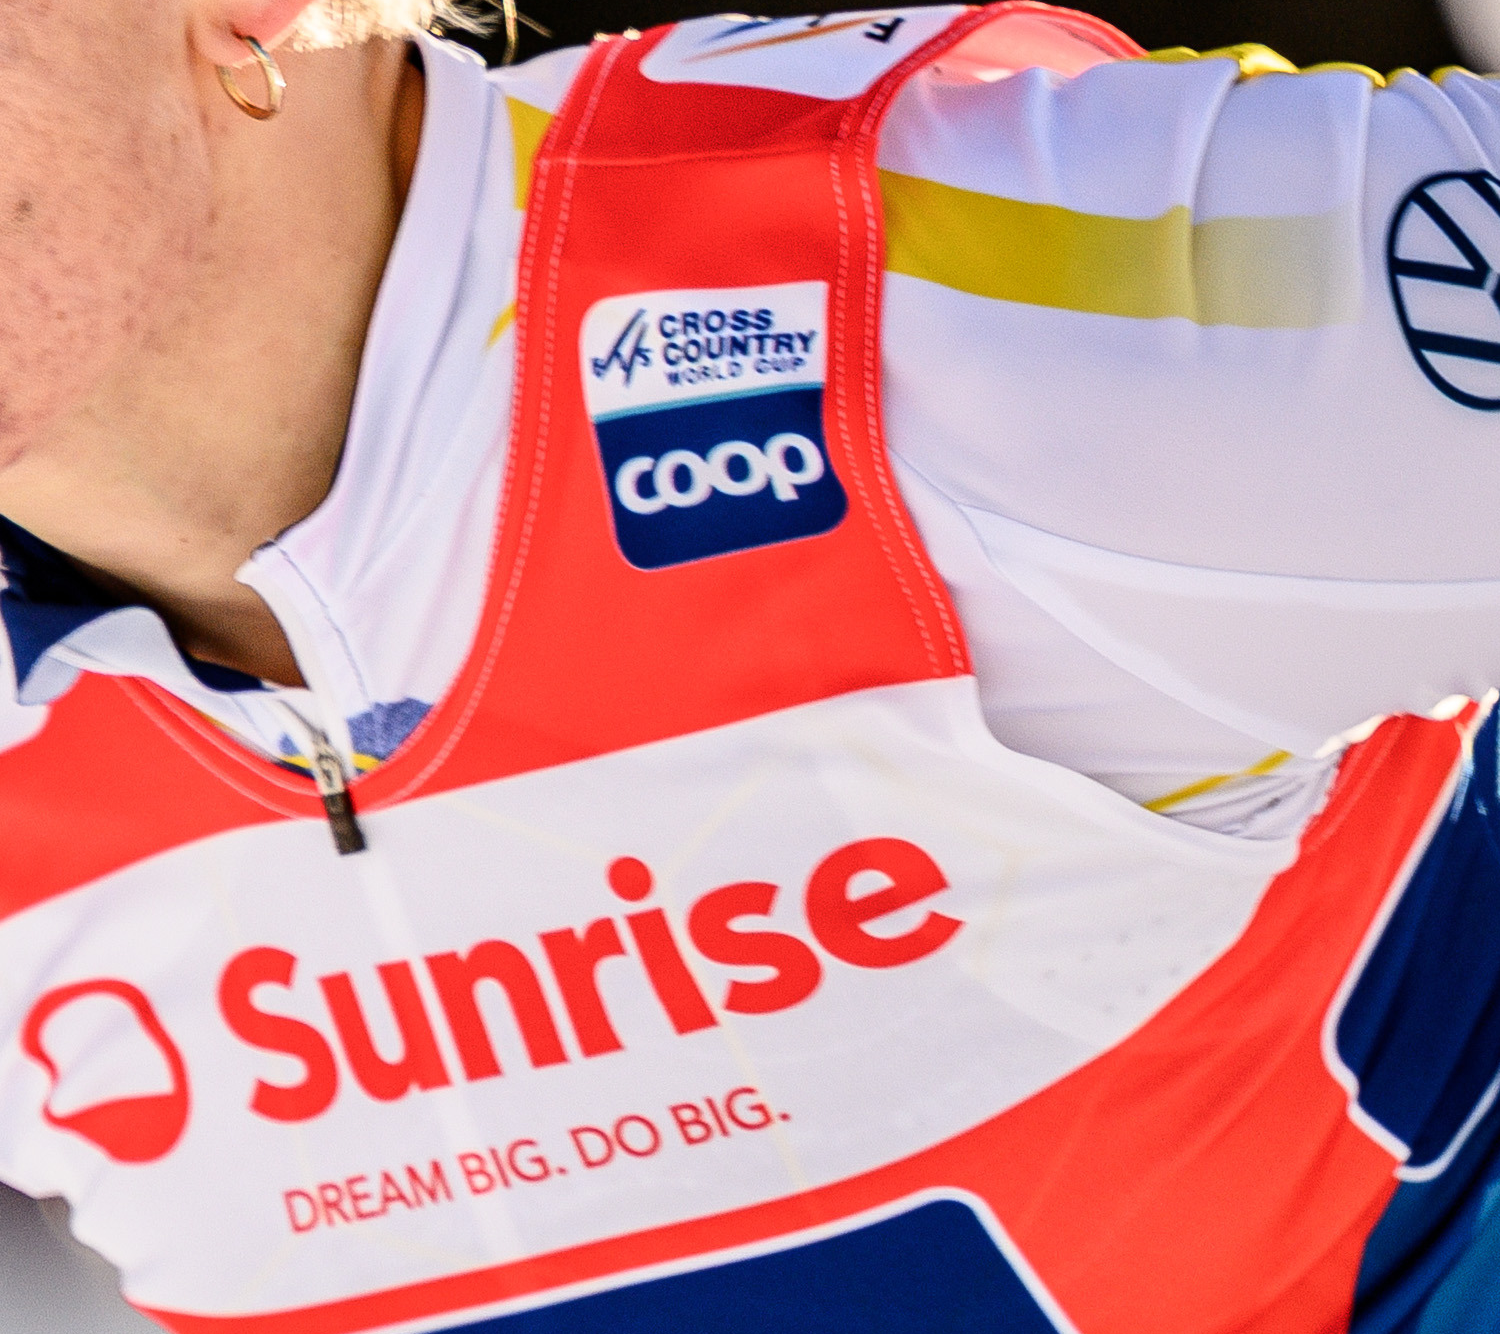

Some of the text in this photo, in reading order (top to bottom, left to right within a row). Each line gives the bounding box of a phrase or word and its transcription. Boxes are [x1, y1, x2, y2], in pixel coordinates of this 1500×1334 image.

[659, 309, 773, 340] CROSS
[662, 331, 817, 366] COUNTRY
[665, 357, 806, 386] WORLD CUP
[614, 432, 825, 515] coop
[217, 836, 966, 1125] Sunrise
[281, 1085, 791, 1234] DREAM BIG. DO BIG.
